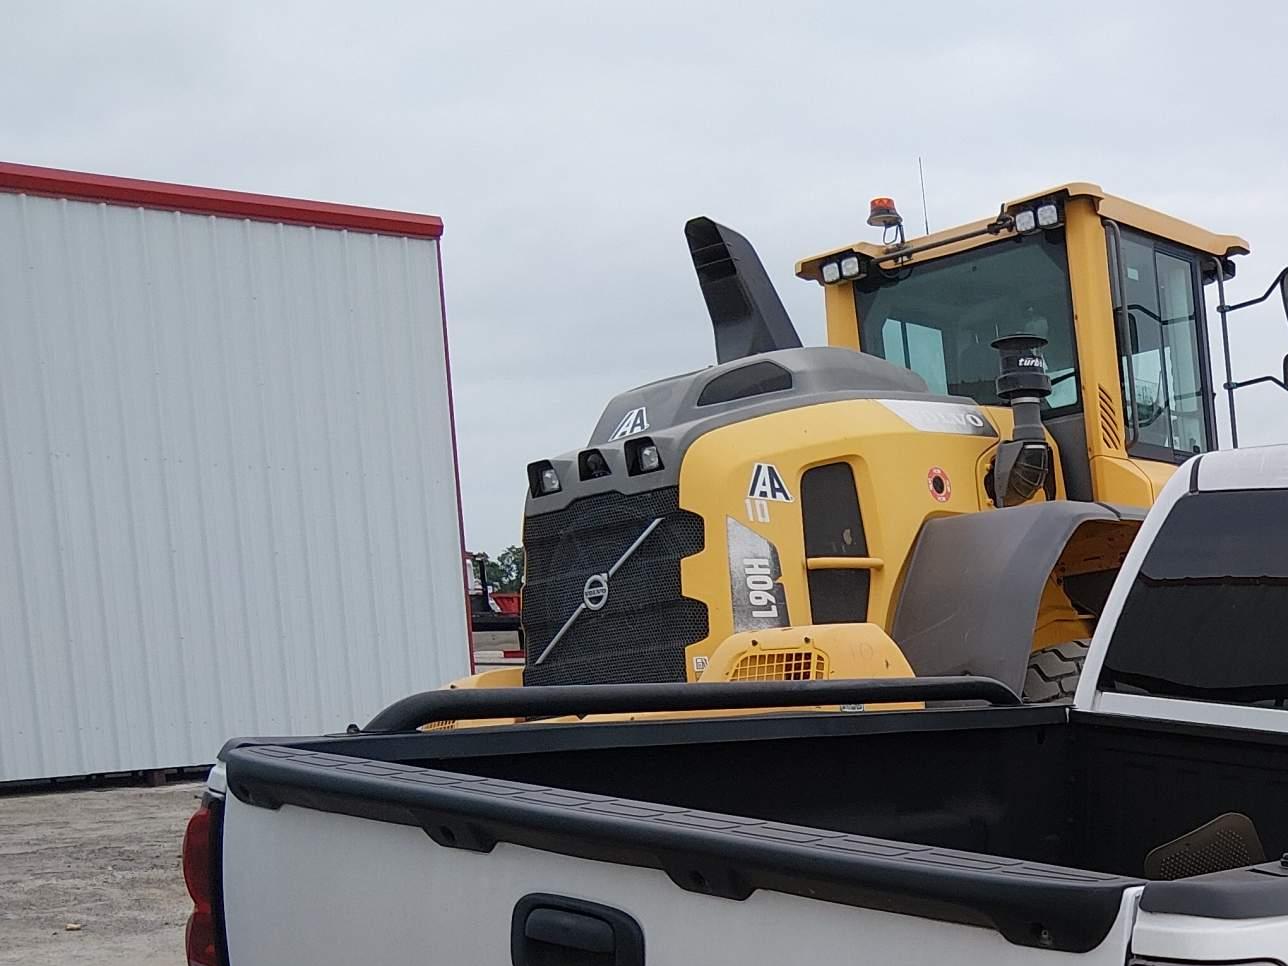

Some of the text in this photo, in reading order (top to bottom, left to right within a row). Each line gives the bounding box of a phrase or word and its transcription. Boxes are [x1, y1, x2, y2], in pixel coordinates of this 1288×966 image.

[609, 406, 649, 441] IAA
[749, 463, 792, 501] IAA
[743, 558, 779, 618] L90H
